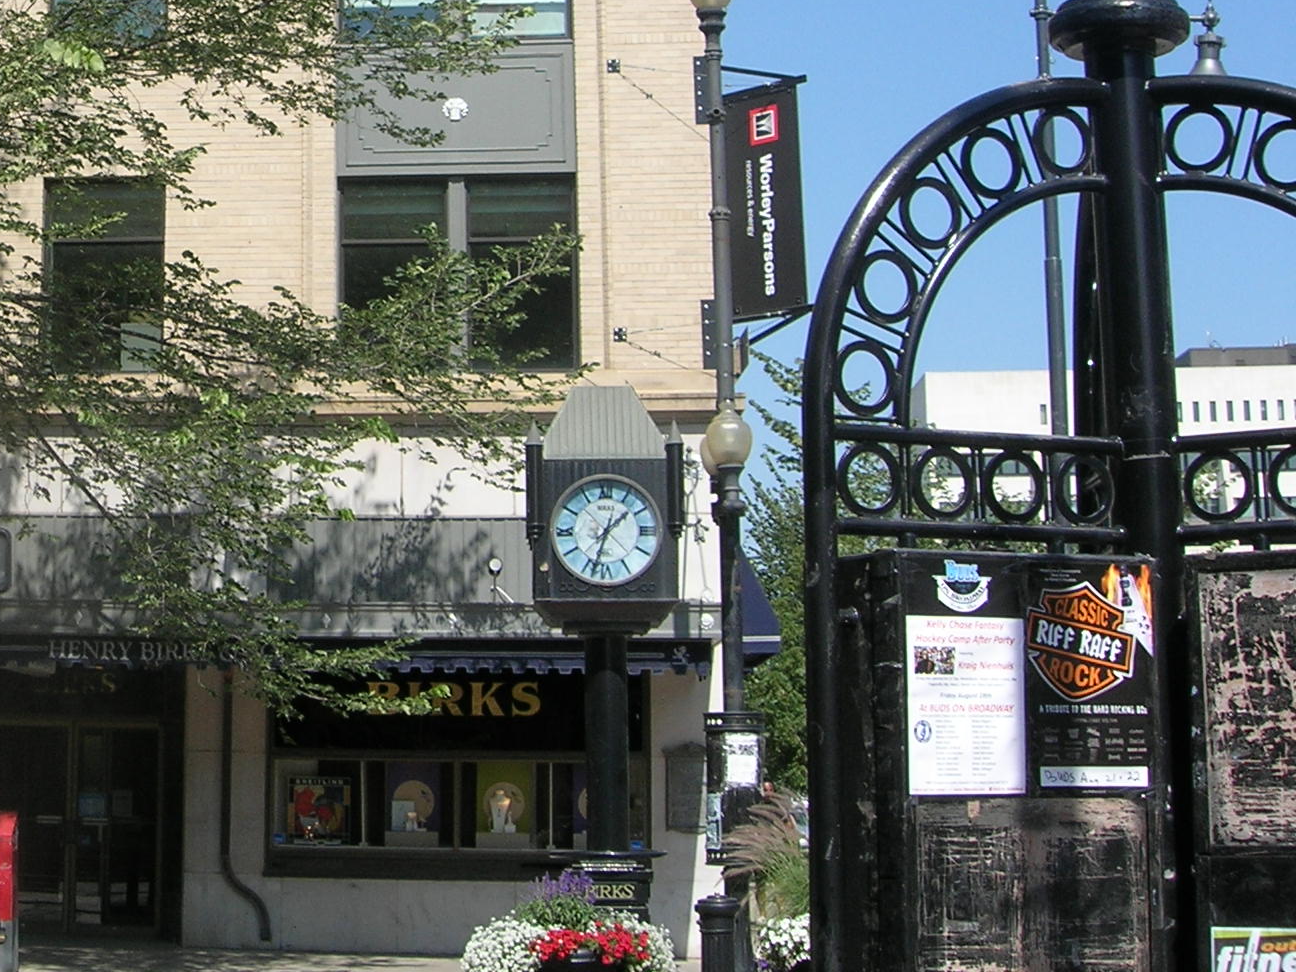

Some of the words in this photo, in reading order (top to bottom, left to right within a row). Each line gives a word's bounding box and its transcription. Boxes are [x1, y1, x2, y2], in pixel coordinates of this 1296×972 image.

[759, 153, 775, 296] WorleyParsons
[1055, 598, 1109, 627] CLASSIC
[48, 639, 133, 661] HENRY
[139, 641, 208, 661] BIRK
[994, 636, 1015, 646] Party
[1036, 619, 1075, 650] RIFF
[1079, 629, 1122, 662] RAFF
[1049, 658, 1101, 687] ROCK
[968, 704, 1015, 713] BROADWAY
[1046, 705, 1071, 714] TRIBUTE
[1080, 705, 1092, 714] THE
[1093, 705, 1109, 714] HARD
